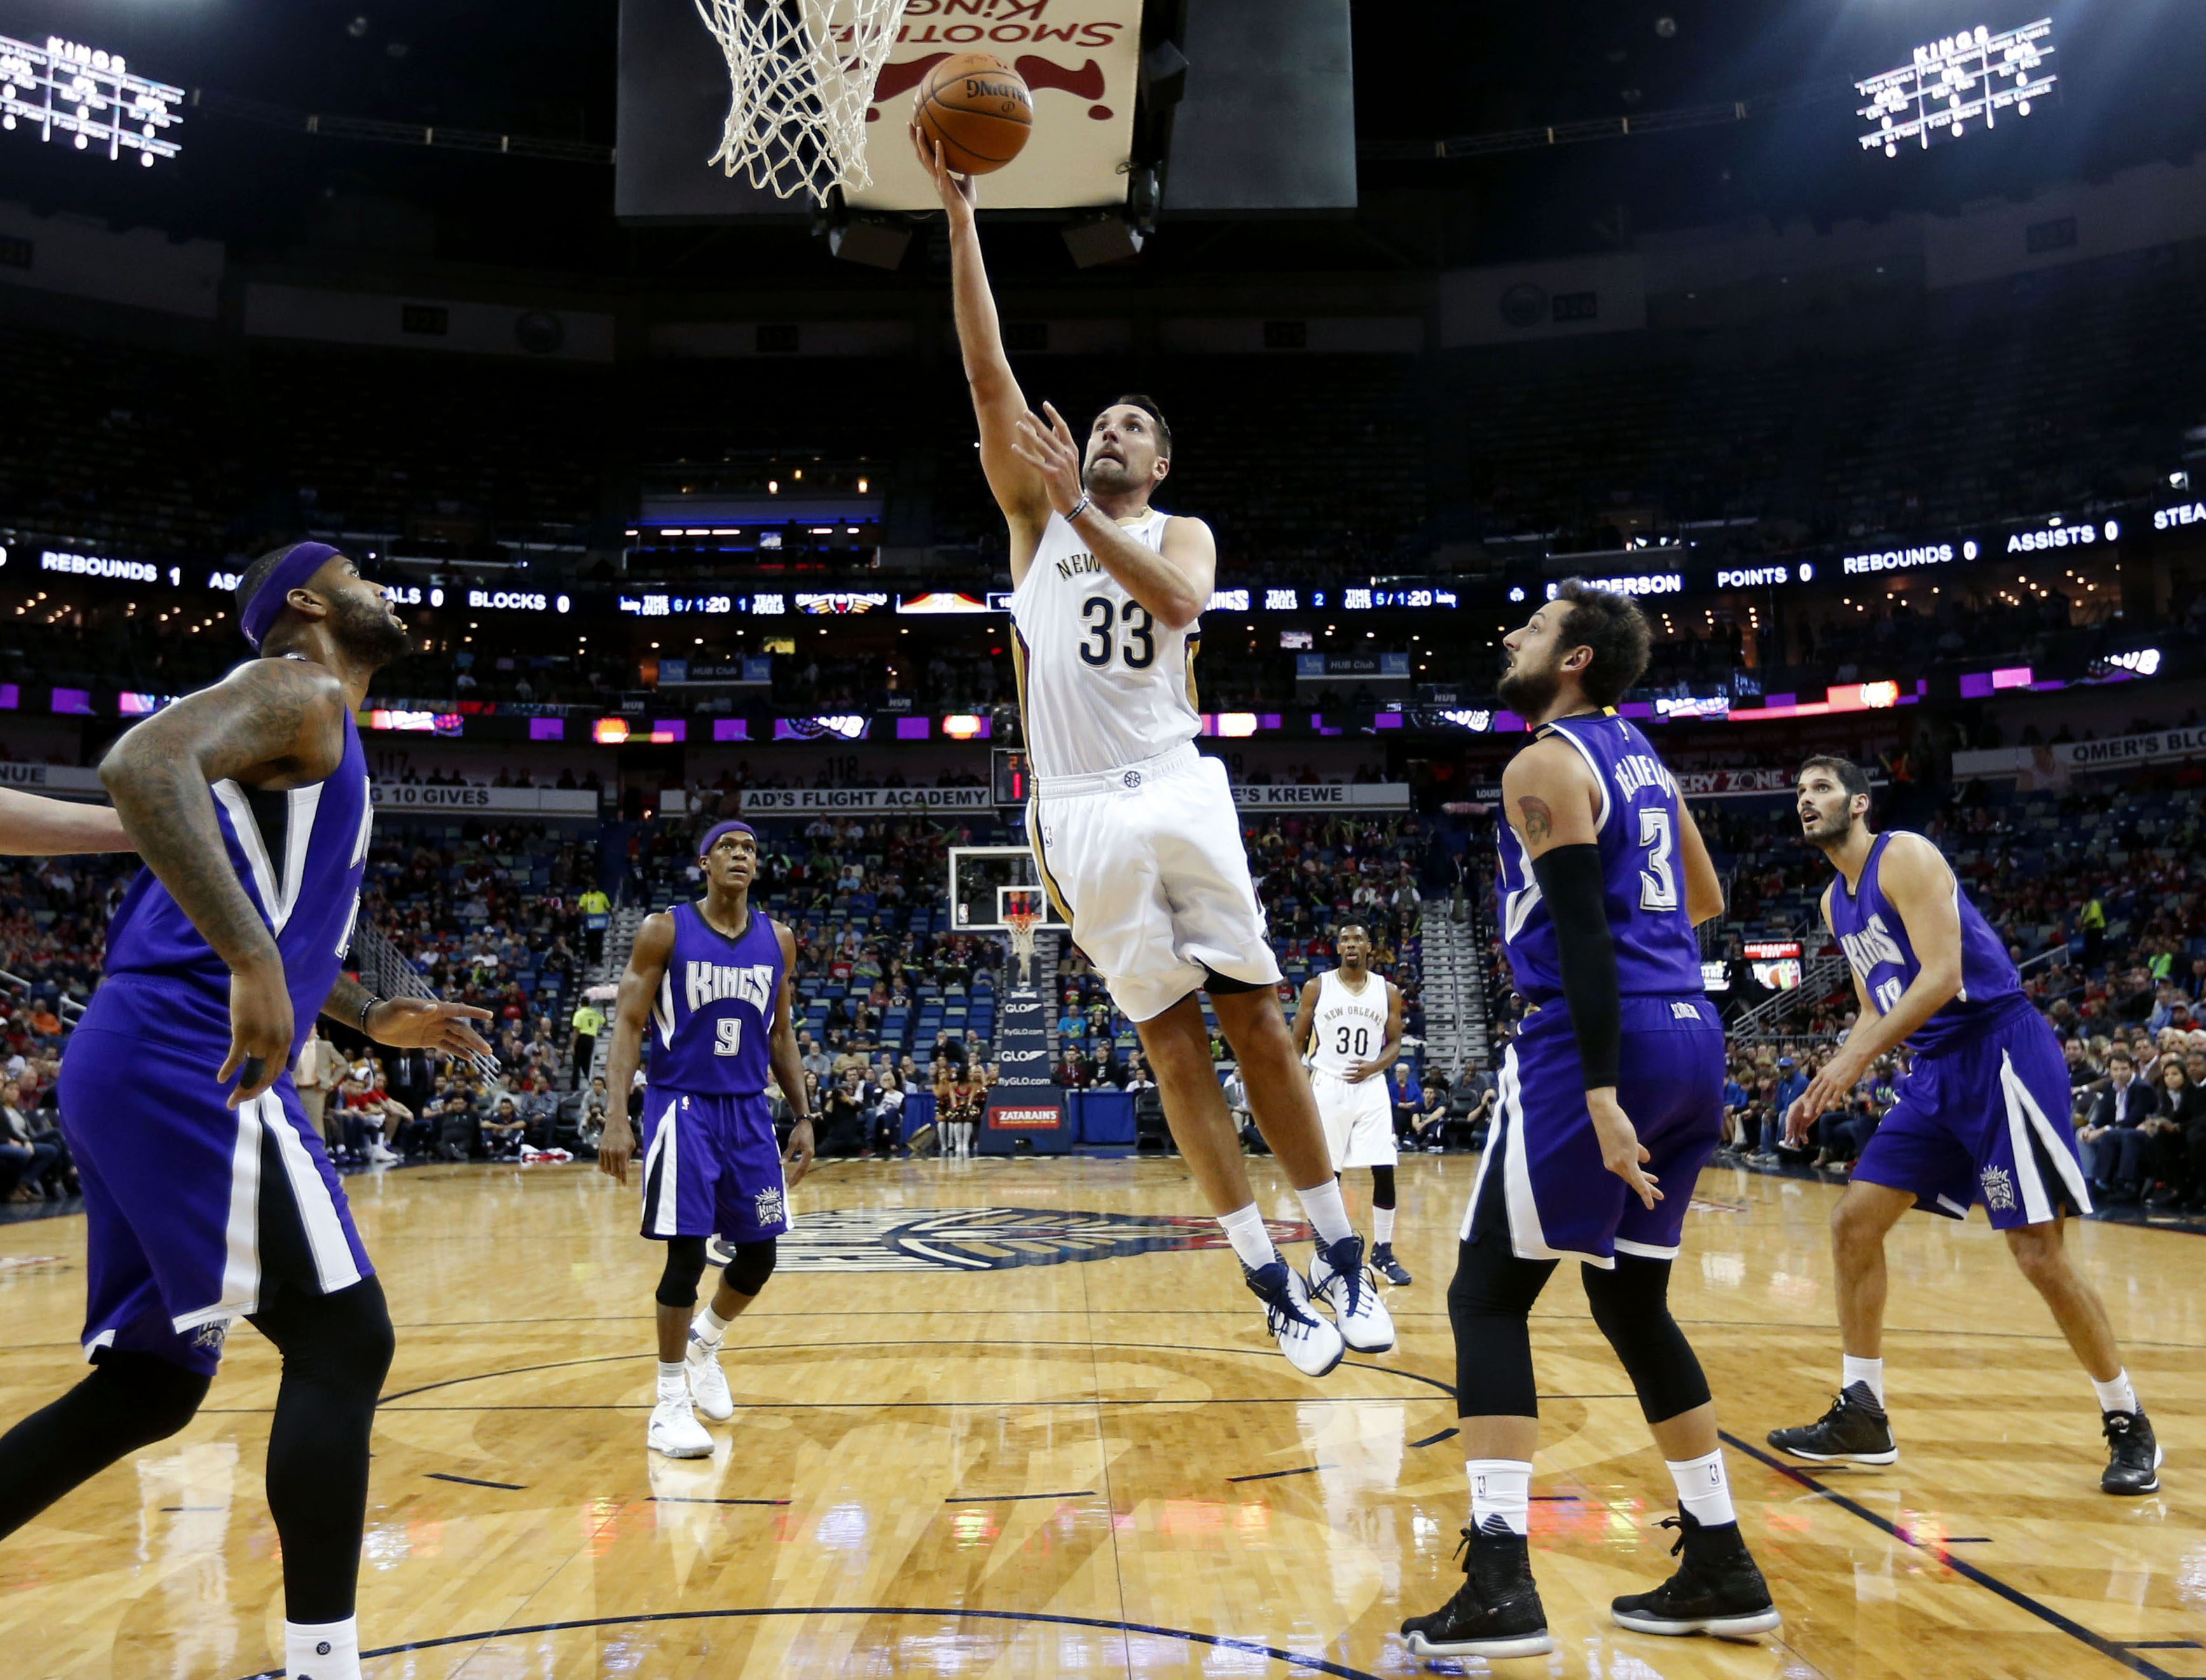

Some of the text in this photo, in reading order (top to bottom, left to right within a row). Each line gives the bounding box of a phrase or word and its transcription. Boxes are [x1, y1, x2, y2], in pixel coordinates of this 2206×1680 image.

[1913, 25, 1989, 64] KINGS
[1844, 544, 1953, 575] REBOUNDS
[1963, 540, 1978, 560] 0
[2006, 525, 2096, 553] ASSISTS
[2104, 520, 2119, 541] 0
[41, 551, 158, 582] REBOUNDS
[169, 567, 181, 586] 1
[431, 589, 444, 607] 0
[469, 591, 547, 610] BLOCKS
[556, 595, 570, 613] 0
[1718, 567, 1788, 588] POINTS
[1799, 563, 1812, 582] 0
[643, 595, 669, 605] TIME
[673, 596, 684, 612] 6
[753, 594, 783, 604] TEAM
[1265, 599, 1297, 609] FOULS
[1266, 589, 1296, 600] TEAM
[1314, 593, 1324, 606] 2
[1345, 589, 1372, 599] TIME
[1375, 593, 1386, 605] 5
[1344, 598, 1372, 609] OUTS
[642, 604, 670, 615] OUTS
[752, 603, 785, 614] FOULS
[1079, 595, 1155, 670] 33
[1330, 661, 1351, 669] HUB
[2072, 736, 2160, 762] OMER'S
[1725, 771, 1784, 790] ZONE
[392, 787, 417, 802] 10
[423, 788, 490, 805] GIVES
[803, 791, 878, 806] FLIGHT
[884, 790, 988, 806] ACADEMY
[1267, 787, 1343, 802] KREWE
[1639, 807, 1678, 912] 3
[1744, 943, 1798, 953] EMERGENCY
[1839, 912, 1906, 989] KINGS
[686, 960, 774, 1016] KINGS
[1005, 1003, 1028, 1014] GLO
[1323, 1005, 1382, 1026] NEW ORLEANS
[714, 1017, 742, 1057] 9
[1336, 1026, 1368, 1056] 30
[1001, 1050, 1029, 1062] GLO
[998, 1077, 1051, 1087] flyGLO.com
